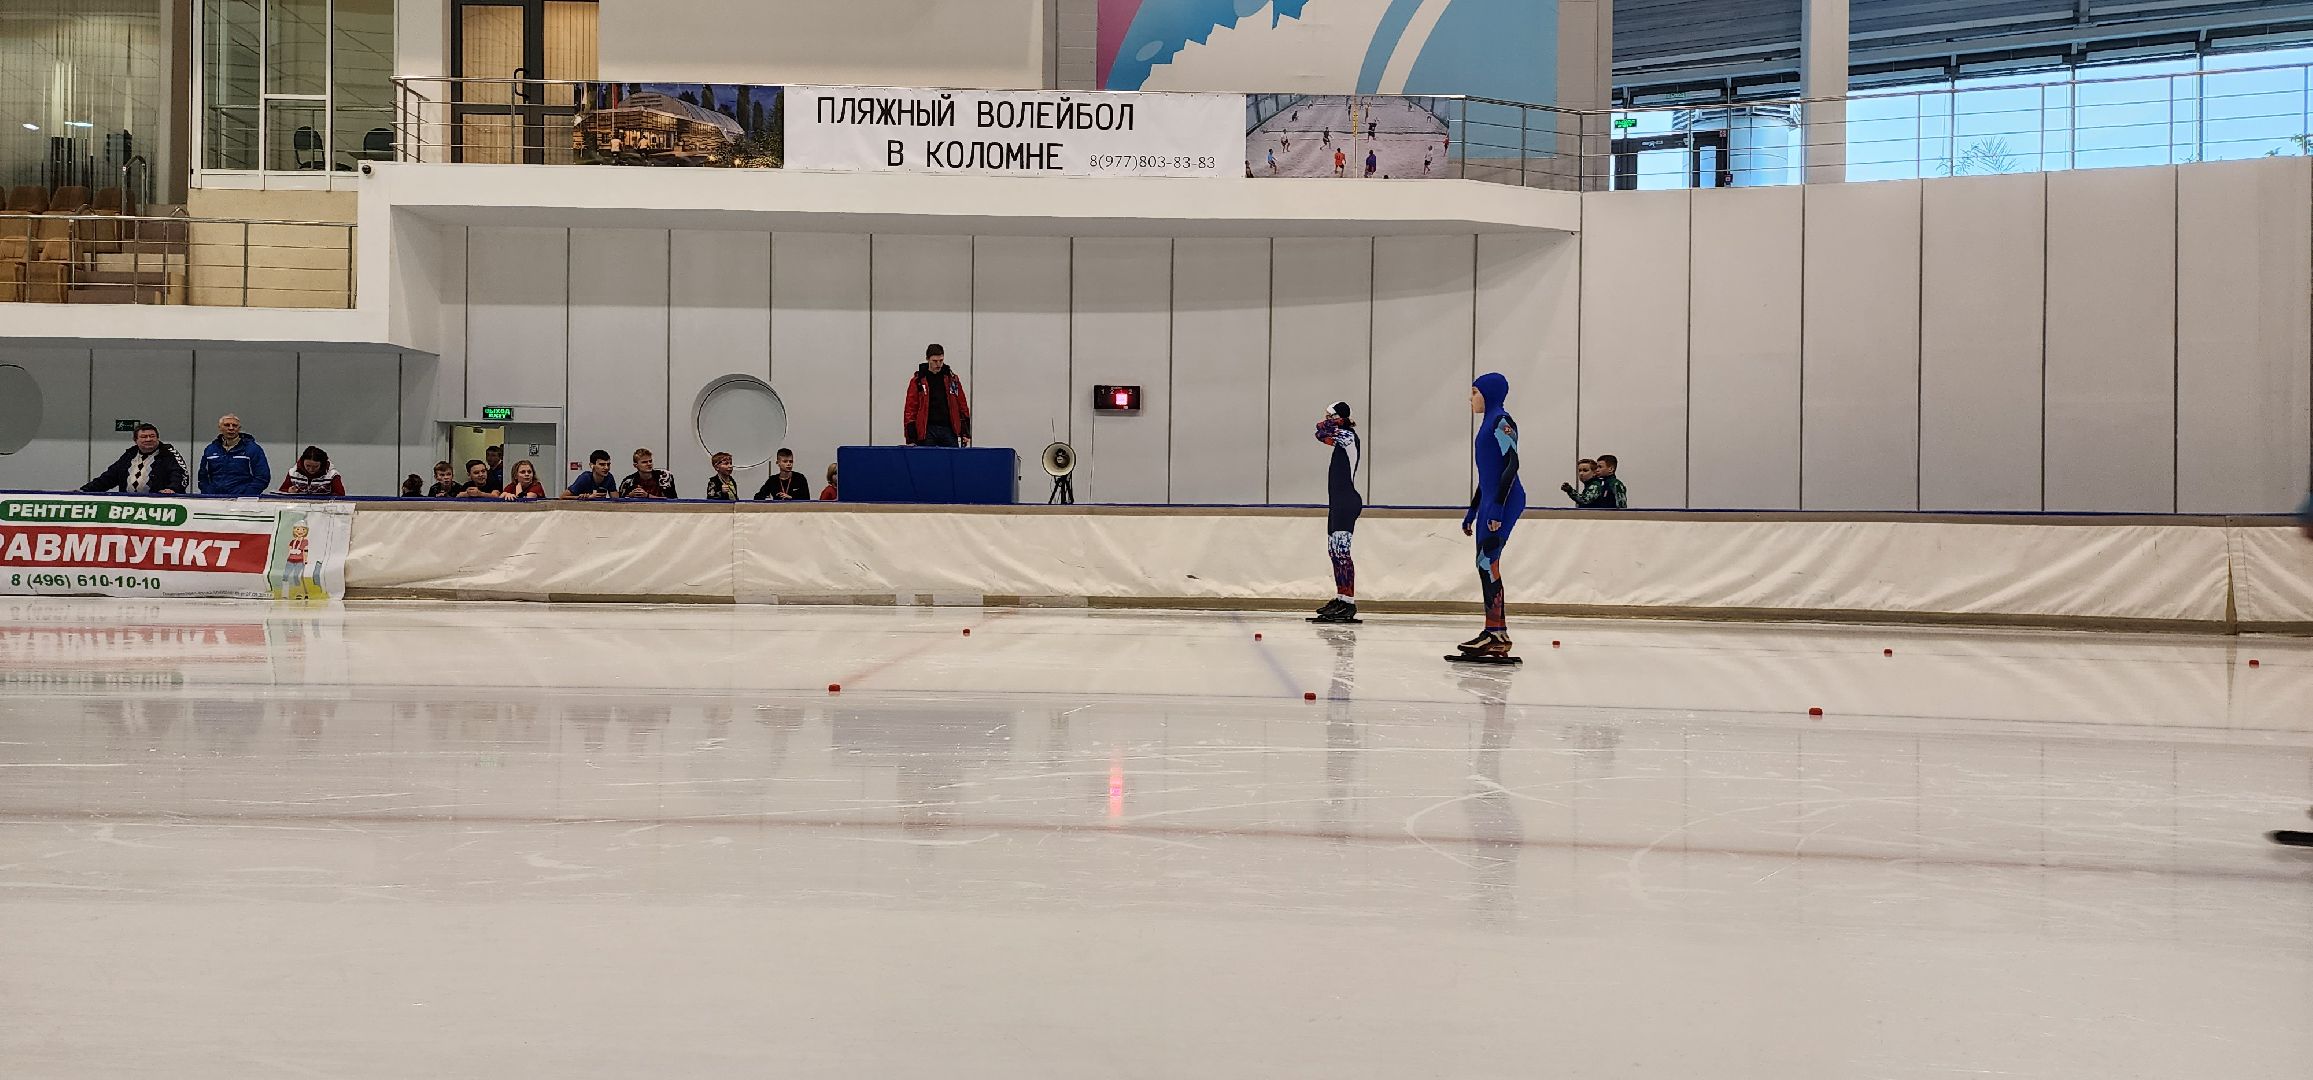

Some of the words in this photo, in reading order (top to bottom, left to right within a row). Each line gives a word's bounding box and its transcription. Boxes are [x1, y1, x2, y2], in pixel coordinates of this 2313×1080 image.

[816, 94, 955, 127] ПЛЯЖНЫЙ
[977, 97, 1135, 131] ВОЛЕЙБОЛ
[887, 139, 904, 167] В
[926, 140, 1064, 170] КОЛОМНЕ
[1089, 154, 1216, 171] 8(977)803-83-83
[8, 503, 97, 519] РЕНТГЕН
[108, 505, 176, 522] ВРАЧИ
[0, 533, 240, 566] АВМПУНКТ
[11, 574, 21, 586] 8
[27, 573, 72, 589] (496)
[77, 574, 161, 590] 610-10-10
